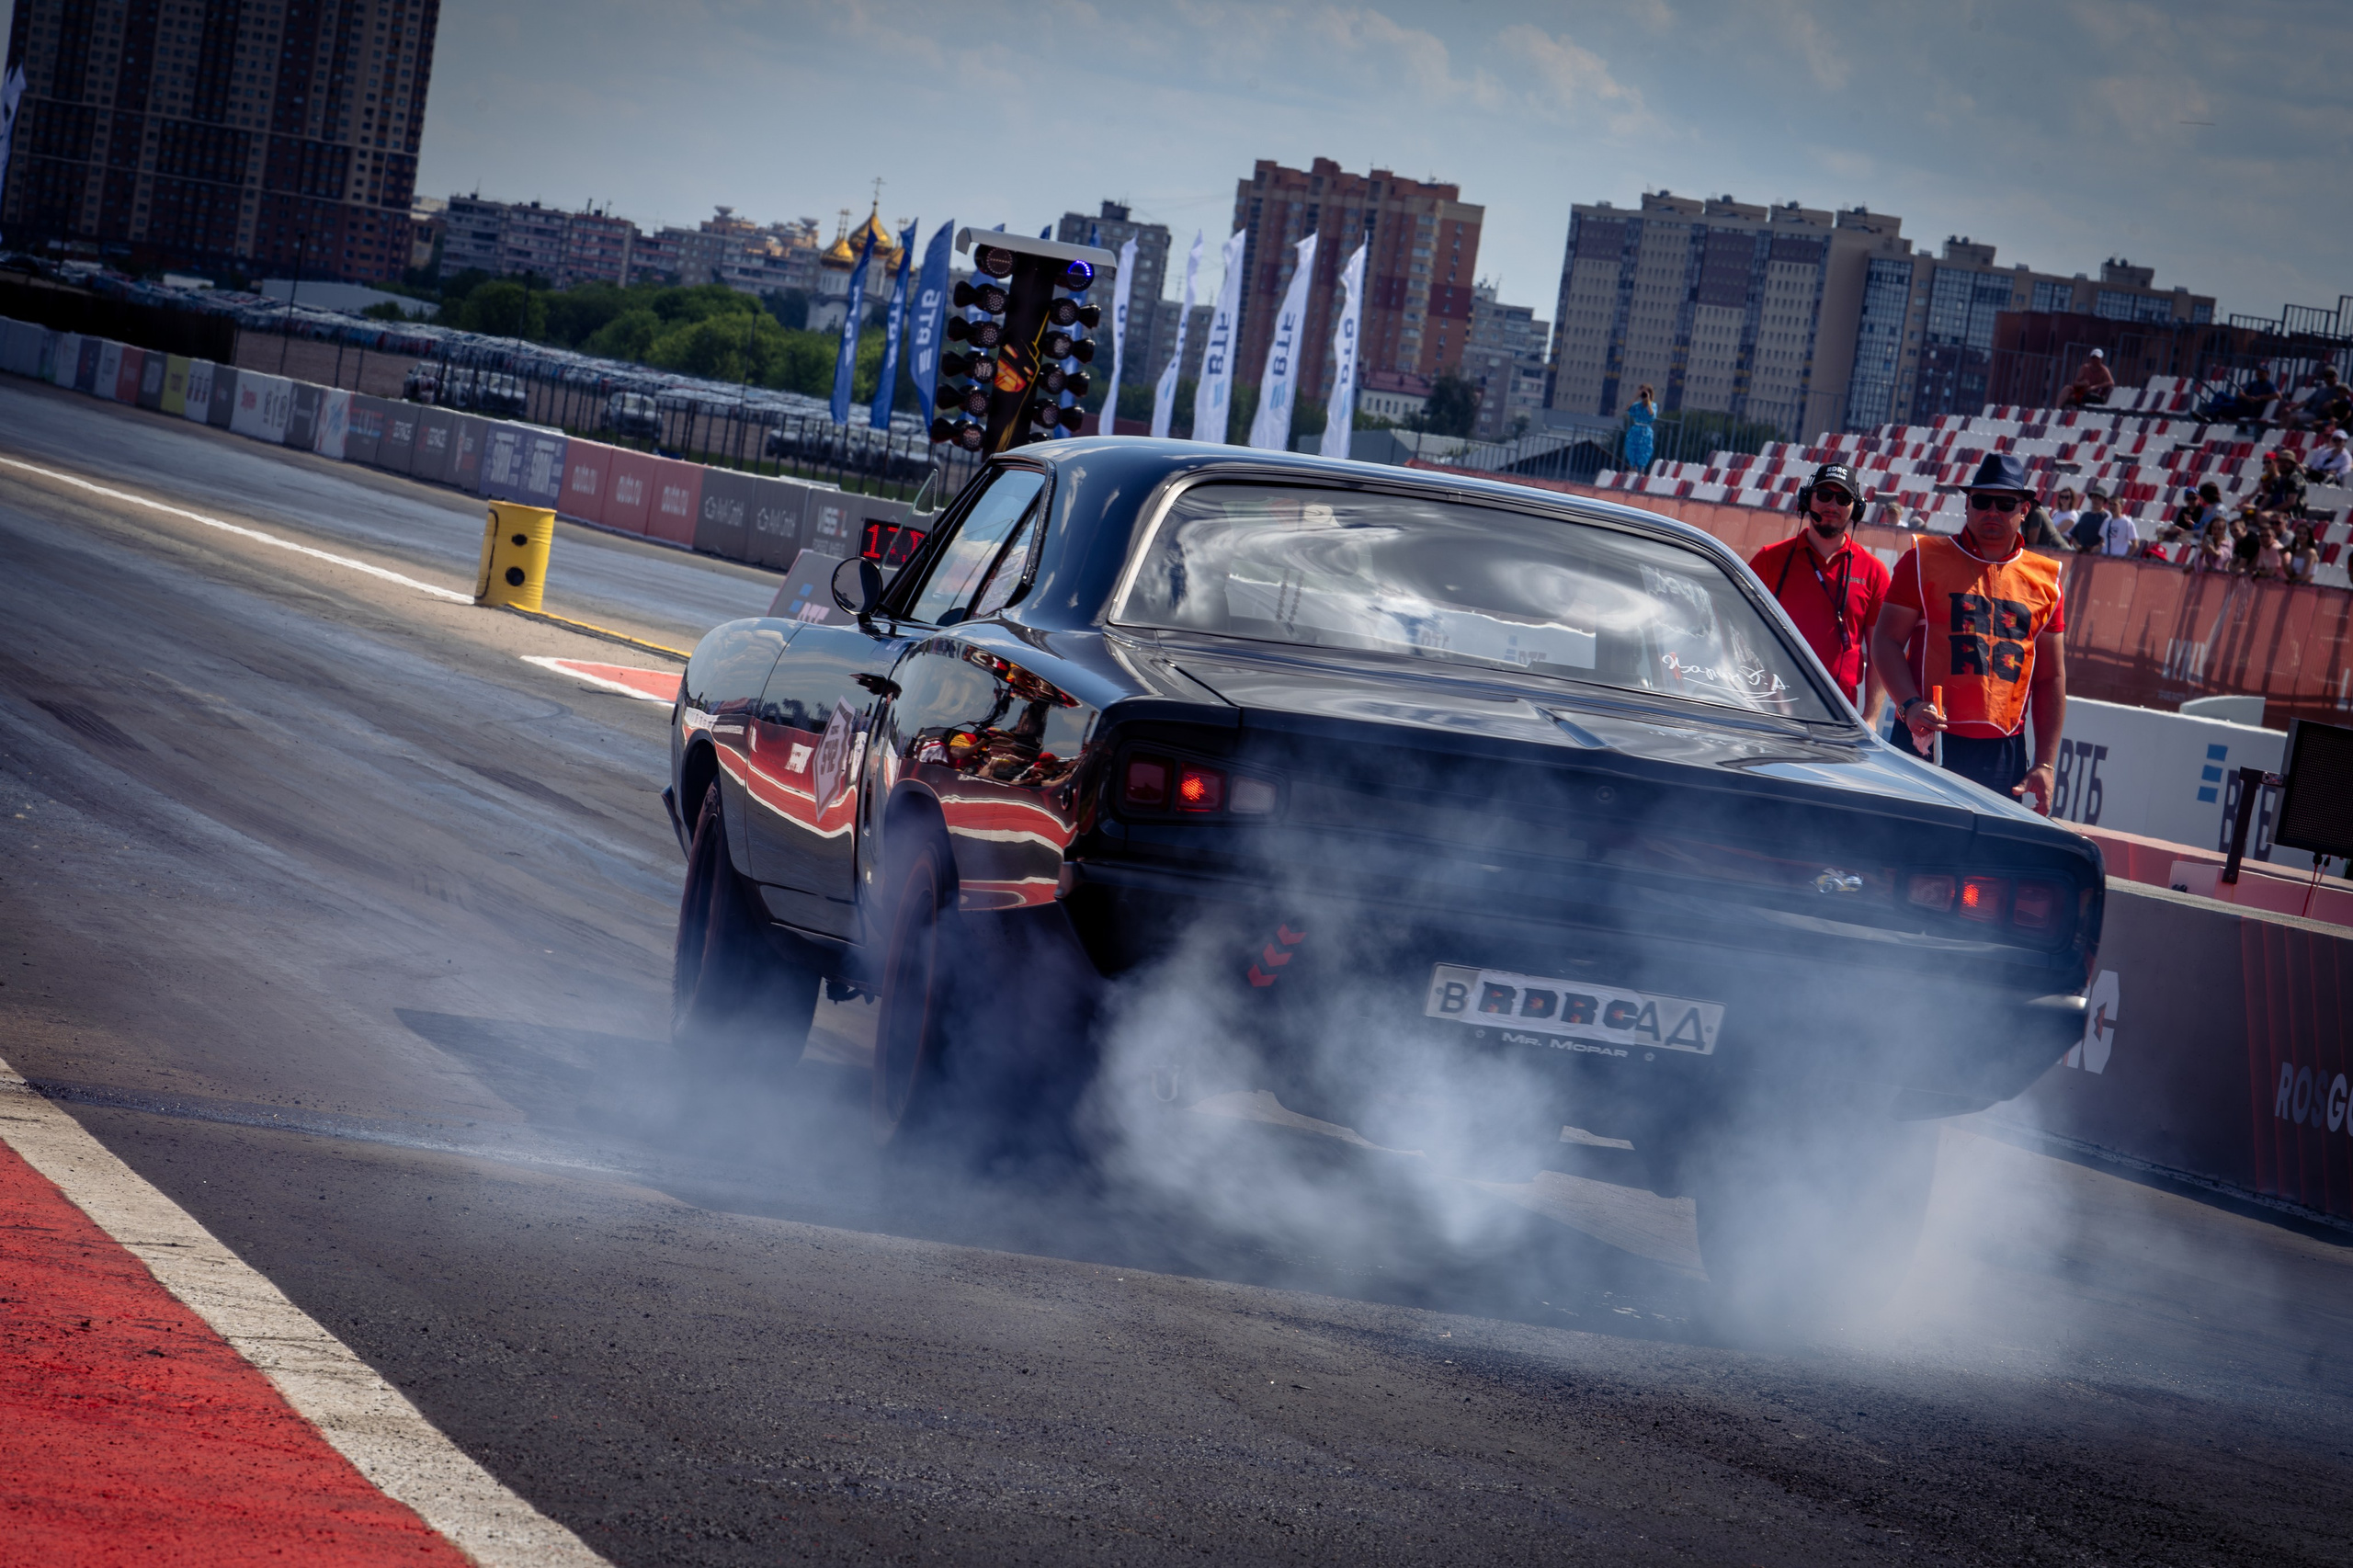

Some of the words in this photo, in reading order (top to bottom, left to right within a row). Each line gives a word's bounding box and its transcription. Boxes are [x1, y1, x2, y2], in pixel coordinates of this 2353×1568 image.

[1826, 466, 1847, 476] RDRC
[1949, 592, 2032, 642] RD
[1948, 634, 2025, 684] RC
[2051, 737, 2109, 825] ВТБ
